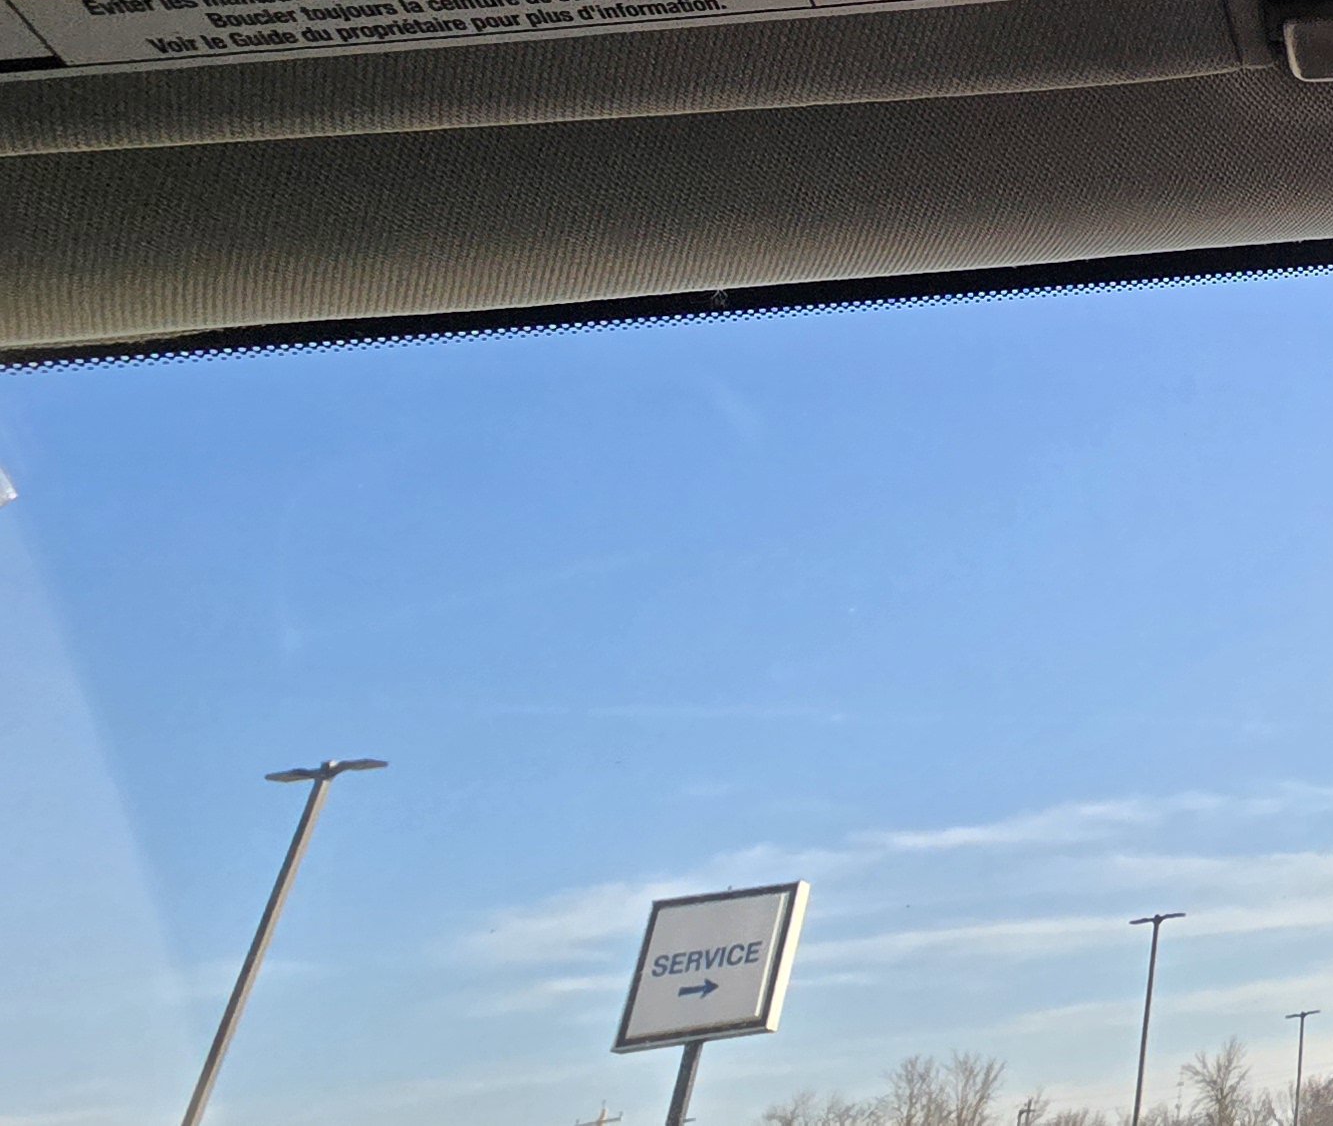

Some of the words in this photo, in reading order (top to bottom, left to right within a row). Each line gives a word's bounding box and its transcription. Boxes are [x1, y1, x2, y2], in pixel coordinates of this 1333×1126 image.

[147, 34, 198, 53] Voir
[201, 32, 224, 49] le
[227, 26, 298, 47] Guide
[301, 24, 334, 41] du
[336, 13, 467, 41] propriétaire
[470, 10, 526, 30] pour
[528, 5, 574, 26] plus
[209, 6, 297, 27] Boucler
[299, 0, 397, 21] toujours
[652, 941, 763, 977] SERVICE
